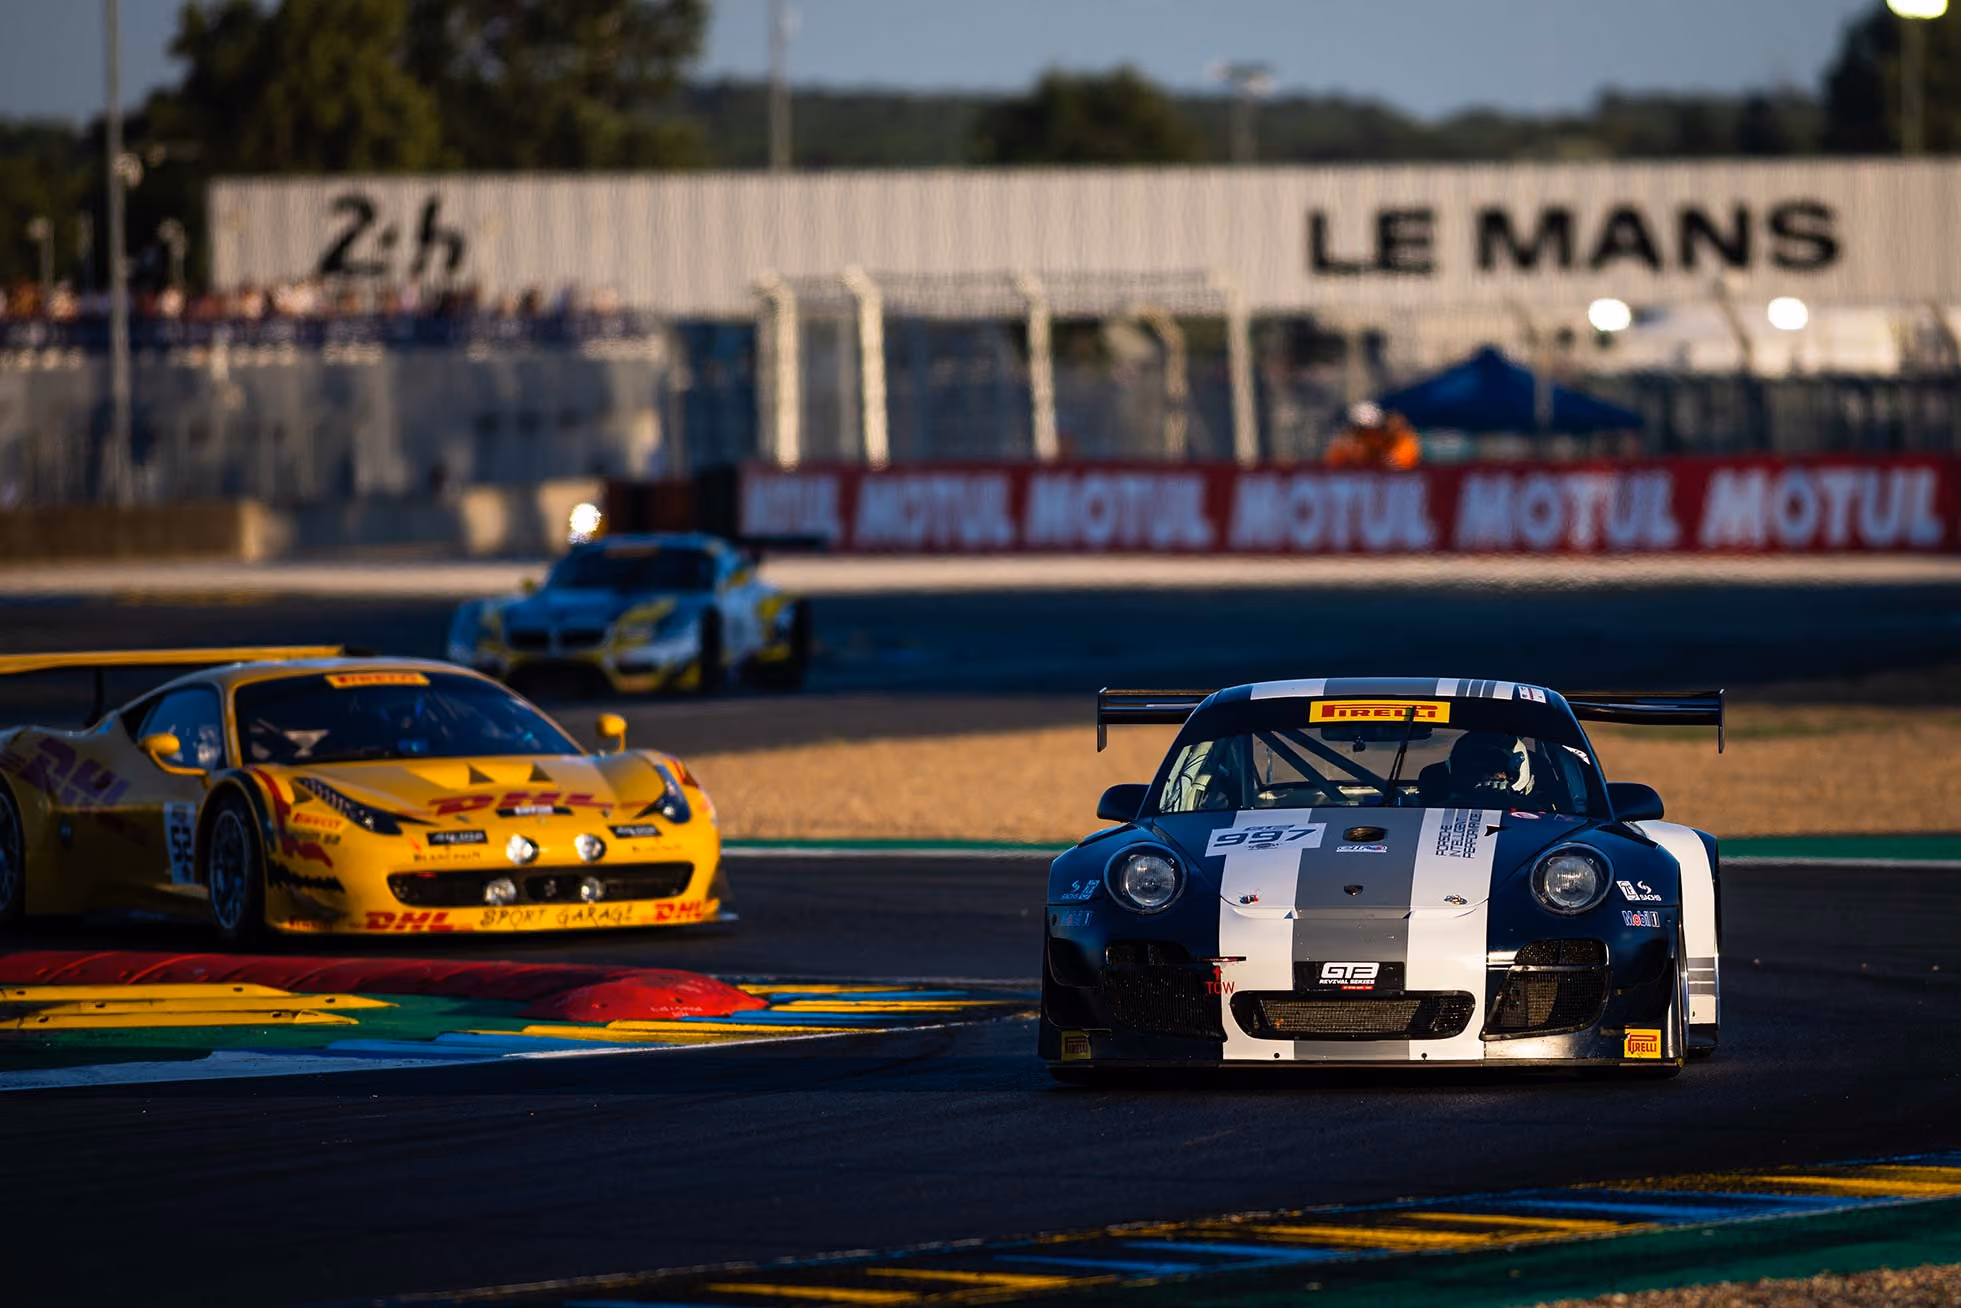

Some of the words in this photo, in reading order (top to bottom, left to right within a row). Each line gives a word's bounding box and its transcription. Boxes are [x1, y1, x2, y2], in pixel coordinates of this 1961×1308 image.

[1308, 206, 1438, 276] LE
[1474, 200, 1845, 273] MANS
[1022, 470, 1213, 548] MOTUL
[1229, 470, 1434, 549] MOTUL
[1452, 468, 1680, 550] MOTUL
[1703, 466, 1943, 550] MOTUL
[1321, 703, 1438, 718] PIRELLI
[428, 790, 615, 816] DHL
[1213, 829, 1316, 848] 997
[365, 911, 453, 931] DHL
[480, 908, 547, 928] SPORT
[655, 902, 704, 921] DHL
[1321, 962, 1379, 979] GT3
[1206, 981, 1235, 994] TOW
[1628, 1034, 1657, 1052] PIRELLI
